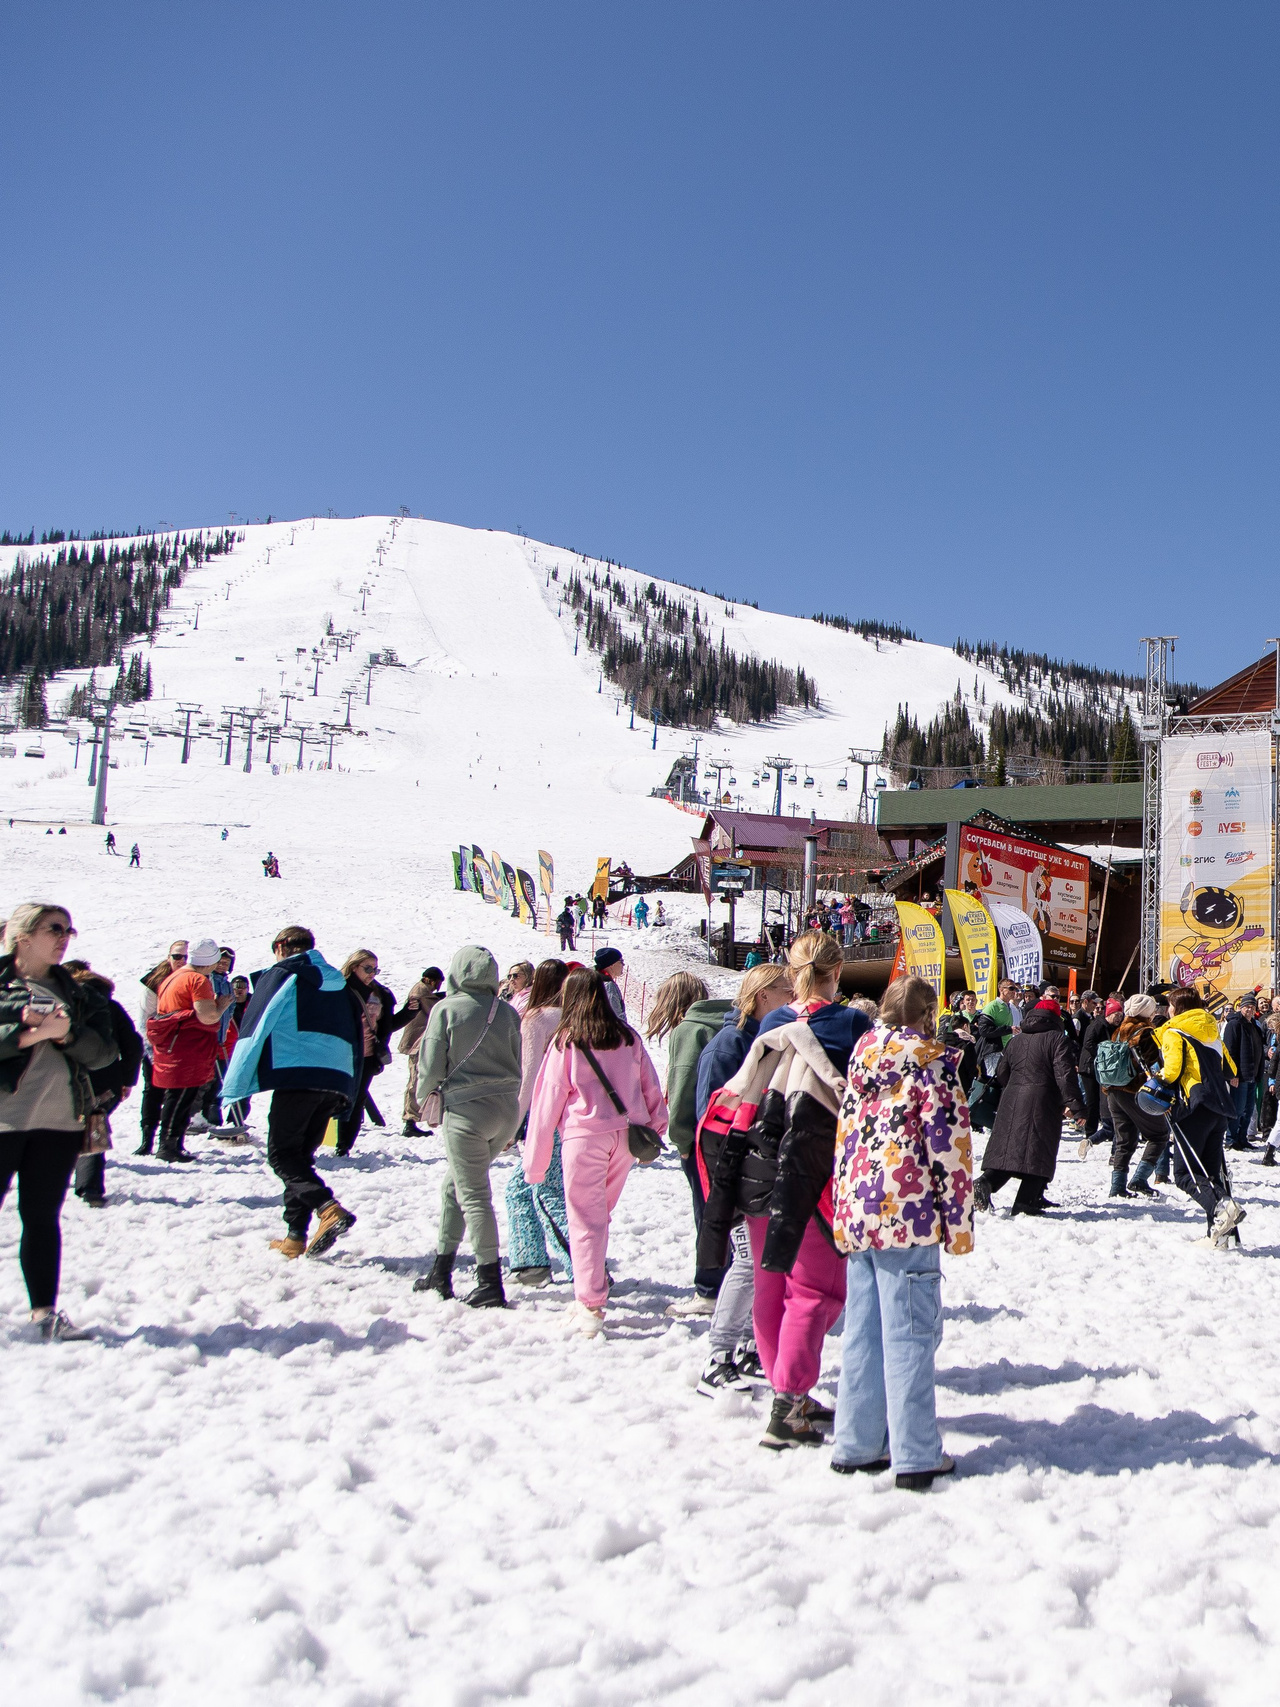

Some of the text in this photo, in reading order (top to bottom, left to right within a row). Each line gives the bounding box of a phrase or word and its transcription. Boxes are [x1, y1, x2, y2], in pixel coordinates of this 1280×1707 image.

[1218, 821, 1246, 834] AYS!
[966, 833, 1085, 871] СОГРЕВАЕМ В ШЕРЕГЕШЕ УЖЕ 10 ЛЕТ!
[1193, 856, 1216, 864] 2ГИС
